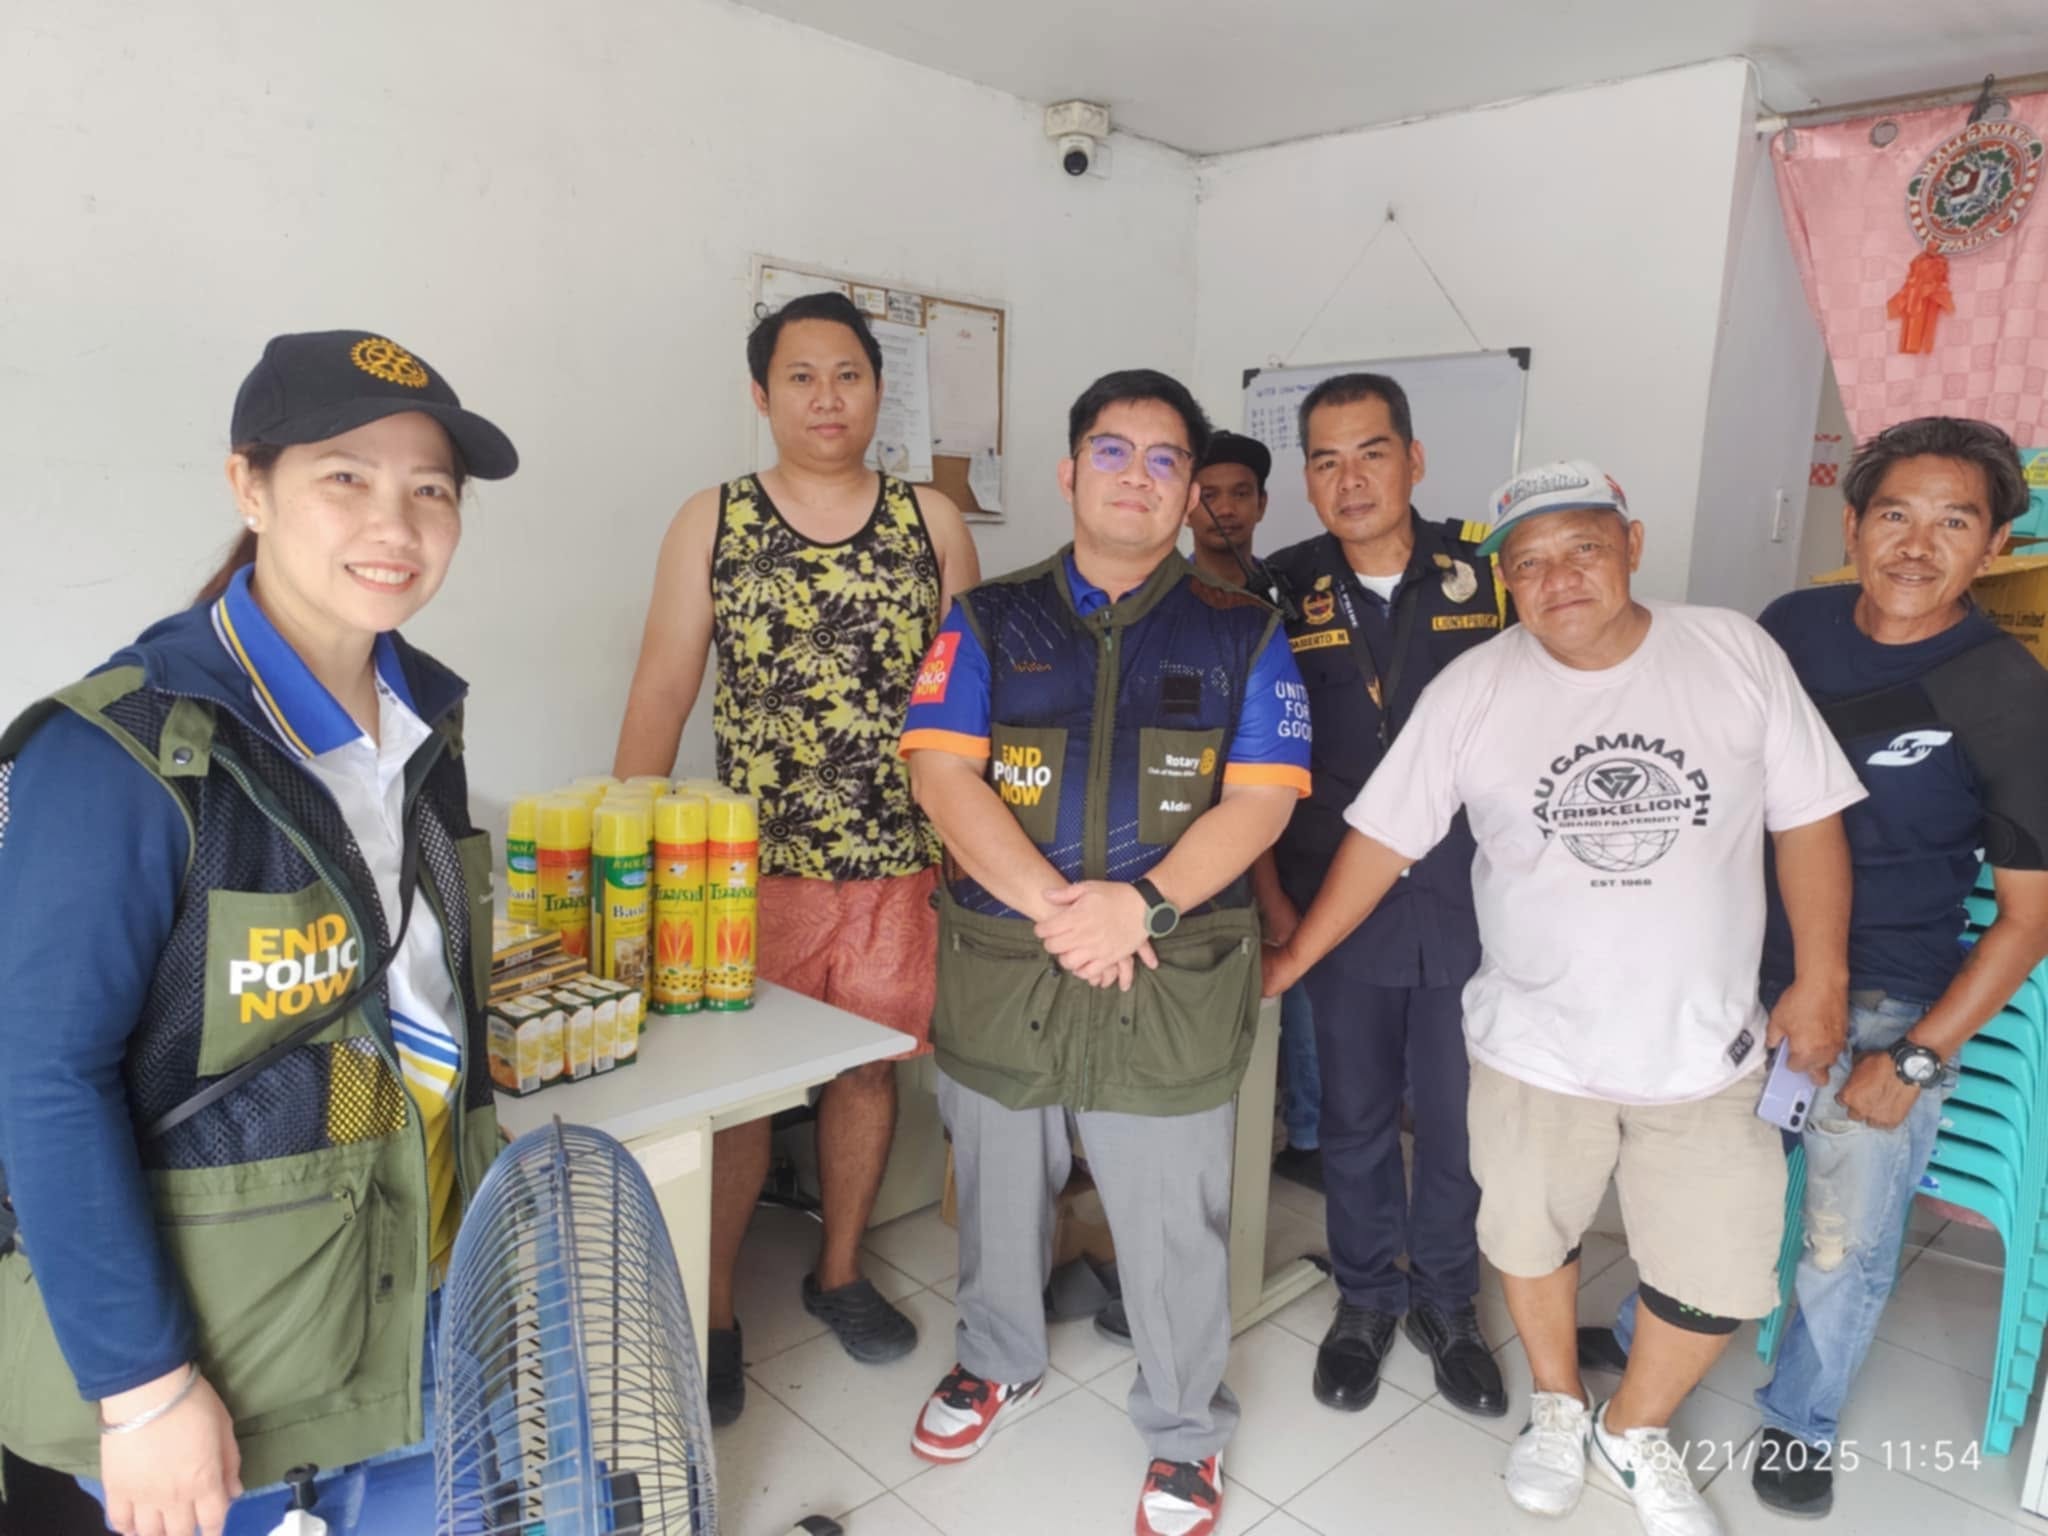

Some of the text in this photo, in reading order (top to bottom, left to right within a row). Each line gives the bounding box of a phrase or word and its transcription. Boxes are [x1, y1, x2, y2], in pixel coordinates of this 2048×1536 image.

[1285, 700, 1310, 721] FOR
[1003, 745, 1042, 767] END
[1165, 753, 1200, 770] Rotary
[993, 760, 1052, 787] POLIO
[1532, 732, 1711, 840] TAU GAMMA PHI
[1000, 781, 1043, 807] NOW
[1552, 797, 1692, 821] TRISKELION
[1558, 815, 1681, 829] GRAND FRATERNITY
[1590, 879, 1616, 888] EST
[249, 913, 347, 963] END
[230, 937, 359, 995] POLIO
[241, 965, 355, 1024] NOW
